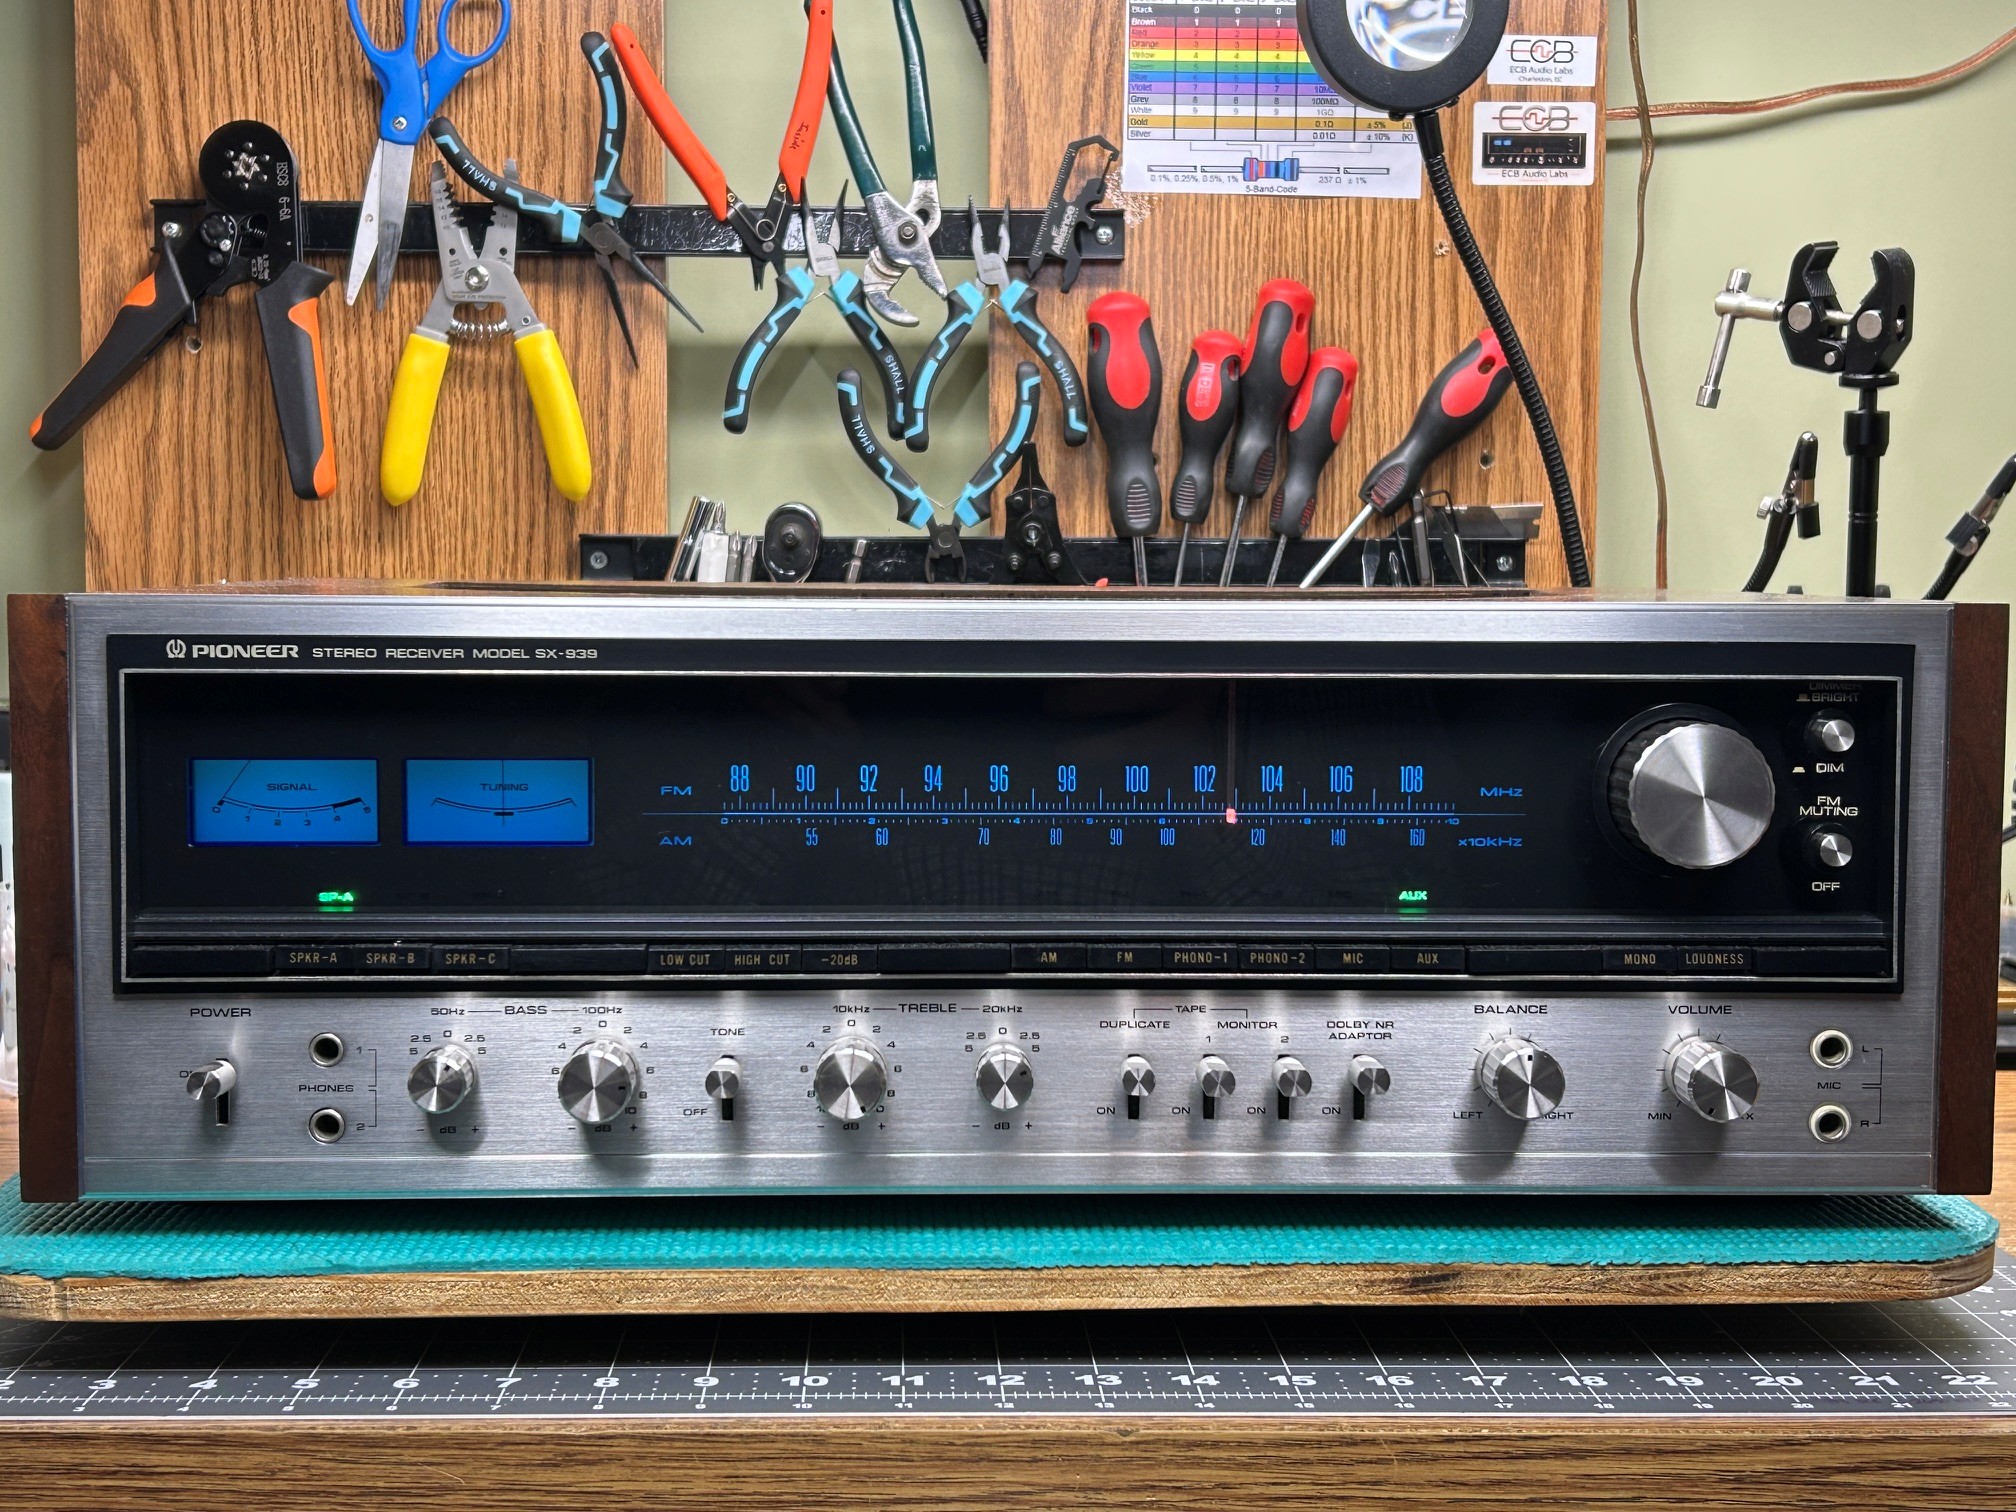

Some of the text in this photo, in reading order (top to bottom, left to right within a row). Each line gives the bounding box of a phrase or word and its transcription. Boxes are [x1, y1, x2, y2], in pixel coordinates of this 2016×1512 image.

[1131, 18, 1156, 26] Brown
[1132, 40, 1159, 48] Orange
[1510, 66, 1573, 74] ECB Audio Labs
[1130, 84, 1152, 92] Violet
[1130, 96, 1149, 104] Grey
[1130, 130, 1151, 138] Silver
[462, 159, 498, 191] SHALL
[1549, 170, 1568, 178] Labs
[884, 354, 905, 394] SHALL
[1054, 360, 1077, 400] SHALL
[852, 414, 876, 454] SHALL
[193, 644, 598, 659] PIONEER STEREO RECEIVER MODEL SX-939
[1812, 693, 1860, 701] BRIGHT
[1816, 763, 1844, 772] DIM
[661, 765, 1523, 797] FM 88 90 92 94 96 98 100 102 104 106 108 MHz
[267, 783, 317, 791] SIGNAL
[480, 783, 528, 792] TUNING
[1817, 796, 1840, 805] FM
[1800, 807, 1858, 816] MUTING
[659, 828, 1522, 847] AM 55 60 70 80 90 100 120 140 160 x10kHz
[1812, 882, 1840, 891] OFF
[1398, 890, 1427, 900] AUX
[289, 952, 337, 963] SPKR-A
[366, 952, 415, 963] SPKR-B
[445, 953, 496, 964] SPKR-C
[660, 954, 711, 965] LOW CUT
[734, 954, 790, 965] HIGH CUT
[822, 954, 858, 966] -20dB
[1041, 952, 1057, 963] AM
[1117, 952, 1133, 963] FM
[1174, 952, 1228, 964] PHONO-1
[1250, 952, 1305, 964] PHONO-2
[1342, 952, 1364, 964] MIC
[1417, 952, 1438, 964] AUX
[1624, 953, 1656, 964] MONO
[1686, 953, 1744, 964] LOUDNESS
[190, 1008, 252, 1017] POWER
[504, 1006, 547, 1014] BASS
[833, 1004, 1022, 1013] 10kHz TREBLE 20kHz
[1175, 1005, 1206, 1013] TAPE
[1474, 1005, 1548, 1014] BALANCE
[1668, 1005, 1732, 1014] VOLUME
[1100, 1021, 1170, 1029] DUPLICATE
[1217, 1021, 1278, 1029] MONITOR
[1327, 1021, 1394, 1029] DOLBY NR
[710, 1028, 745, 1036] TONE
[1329, 1032, 1392, 1040] ADAPTOR
[1817, 1082, 1841, 1090] MIC
[1453, 1111, 1483, 1120] LEFT
[1541, 1111, 1574, 1120] IGHT
[1648, 1112, 1672, 1120] MIN
[93, 1375, 1998, 1389] 3 4 5 6 7 8 9 10 11 12 13 14 15 16 17 18 19 20 21 22
